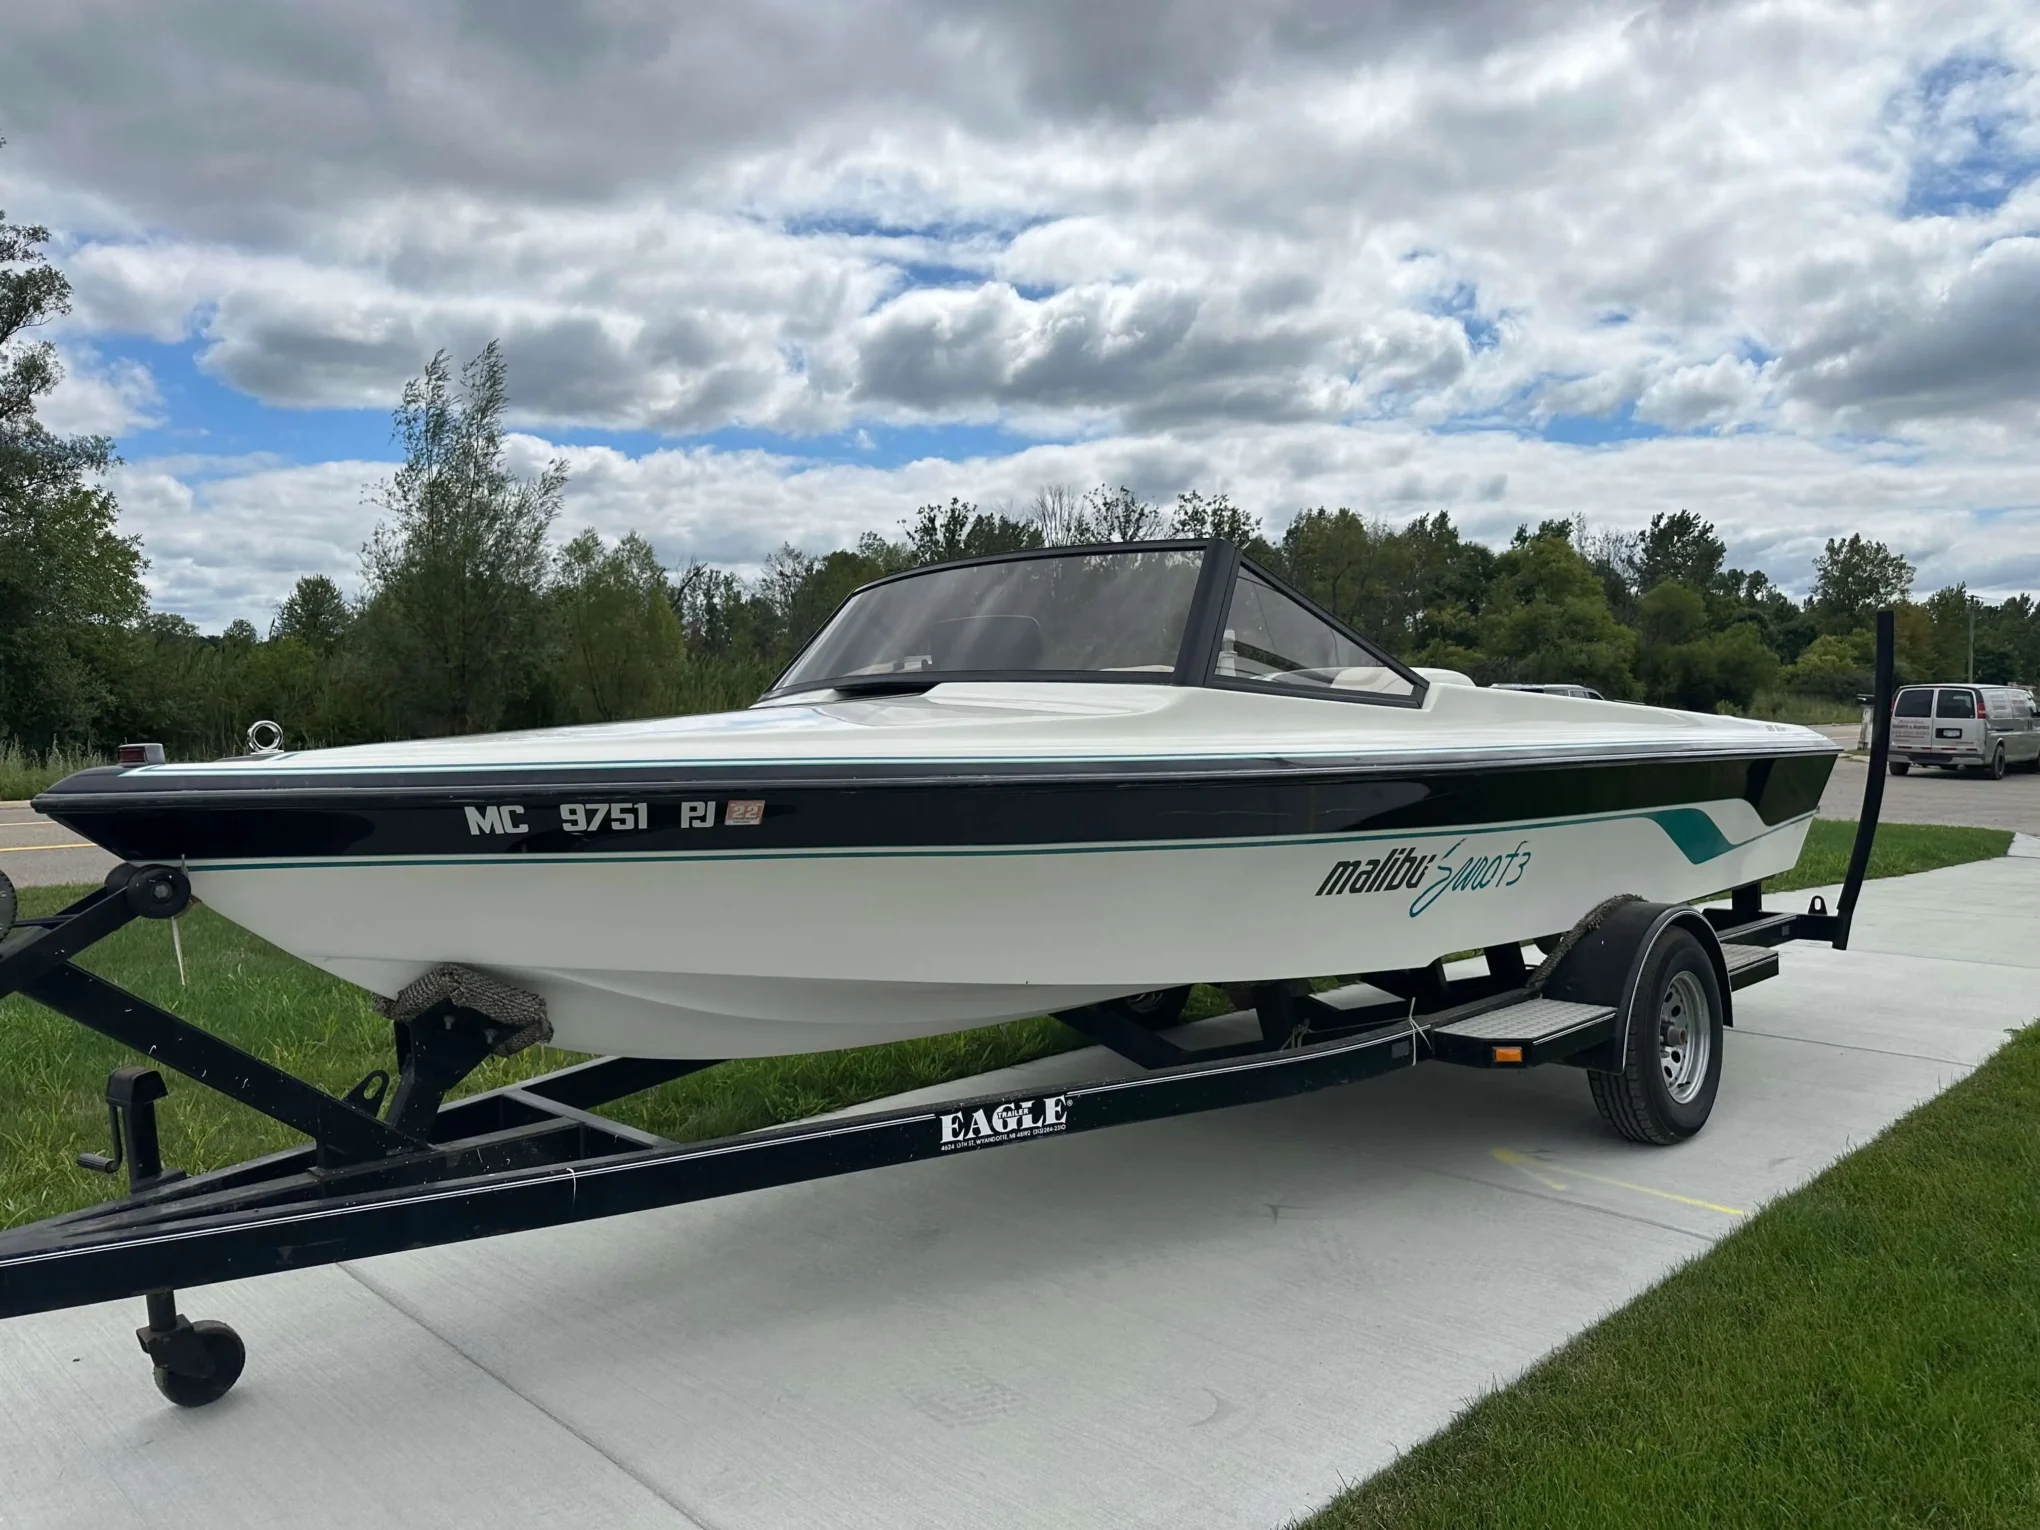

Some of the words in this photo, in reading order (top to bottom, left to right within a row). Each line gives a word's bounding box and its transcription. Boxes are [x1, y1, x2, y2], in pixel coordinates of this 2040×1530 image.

[464, 805, 529, 835] MC
[560, 803, 648, 831] 9751
[681, 801, 716, 828] PJ
[732, 805, 760, 818] 22
[1315, 847, 1437, 896] malibu
[940, 1095, 1067, 1143] EAGLE
[997, 1108, 1029, 1119] TRAILER
